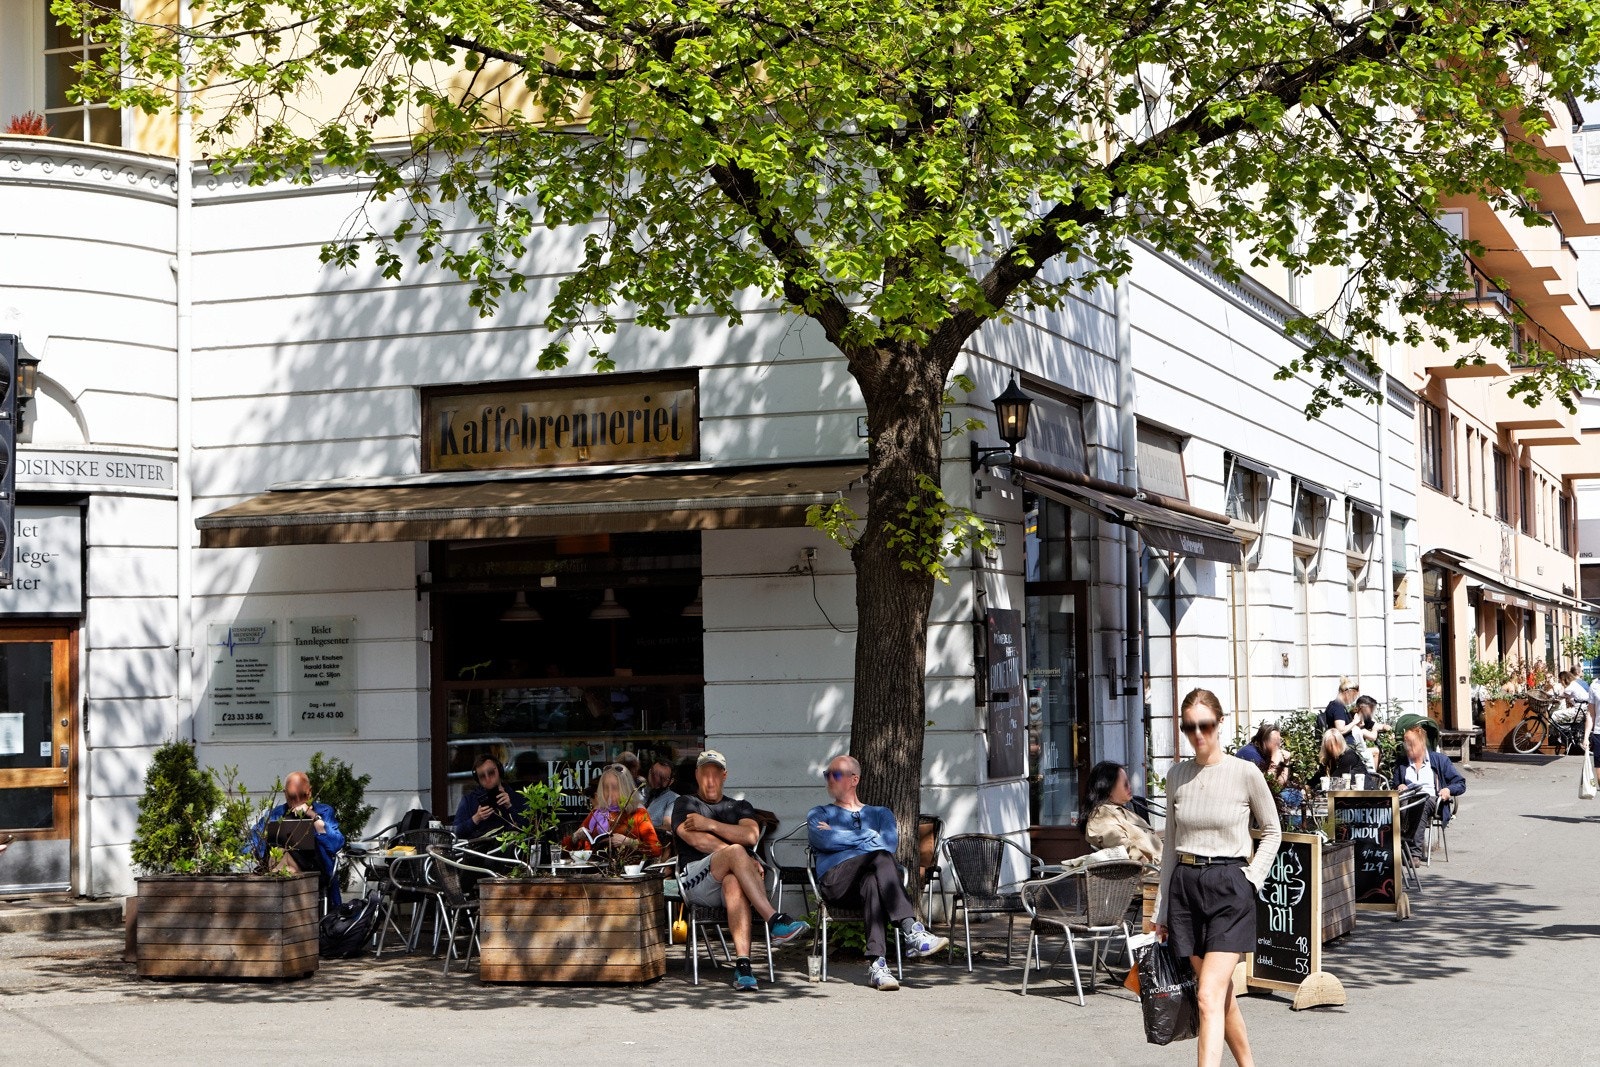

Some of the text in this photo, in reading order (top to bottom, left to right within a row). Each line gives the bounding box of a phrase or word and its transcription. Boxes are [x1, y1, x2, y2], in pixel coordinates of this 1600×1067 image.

[440, 395, 684, 456] Kaffebrenneriet
[105, 462, 165, 481] SENTER
[13, 521, 39, 538] let
[311, 626, 332, 634] Bislet
[294, 637, 350, 647] Tannlegesenter
[1266, 851, 1294, 883] afe
[1270, 883, 1288, 907] au
